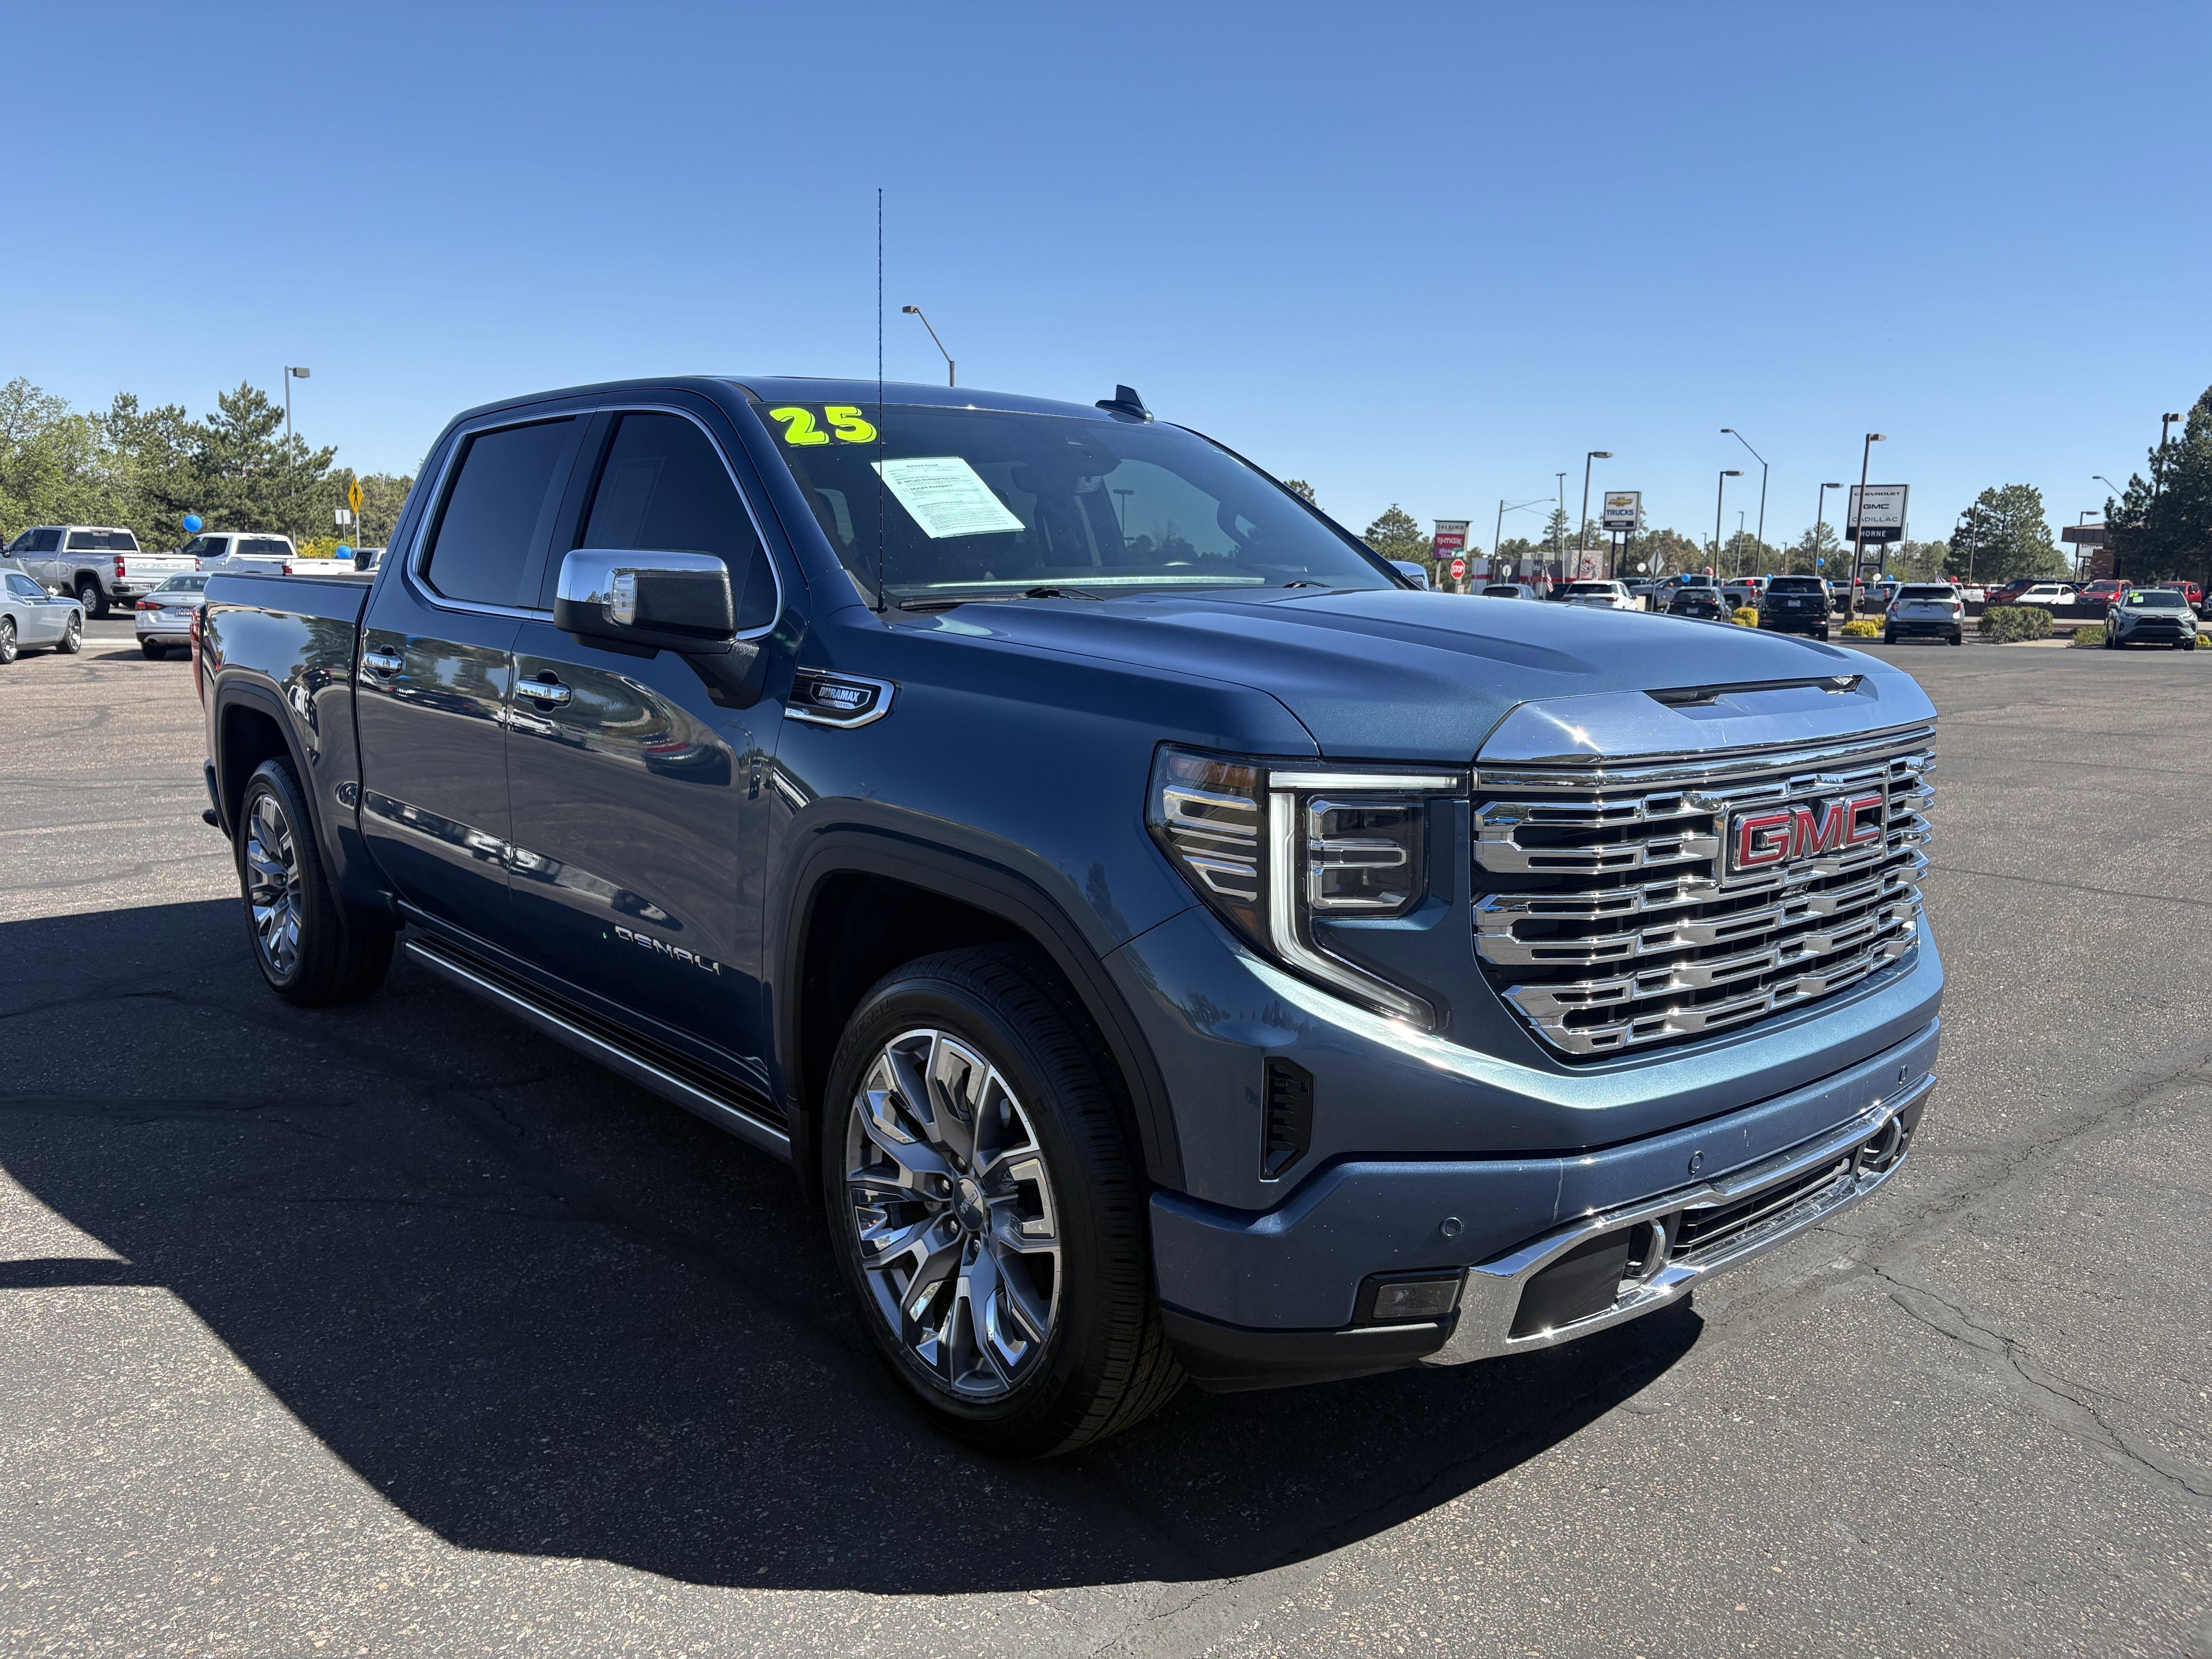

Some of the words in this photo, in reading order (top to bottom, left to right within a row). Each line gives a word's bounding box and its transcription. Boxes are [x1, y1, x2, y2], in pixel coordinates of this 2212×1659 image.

[769, 406, 877, 445] 25
[1452, 565, 1464, 574] STOP
[818, 687, 860, 702] DURAMAX
[1733, 790, 1883, 871] GMC
[615, 925, 721, 976] DENALI
